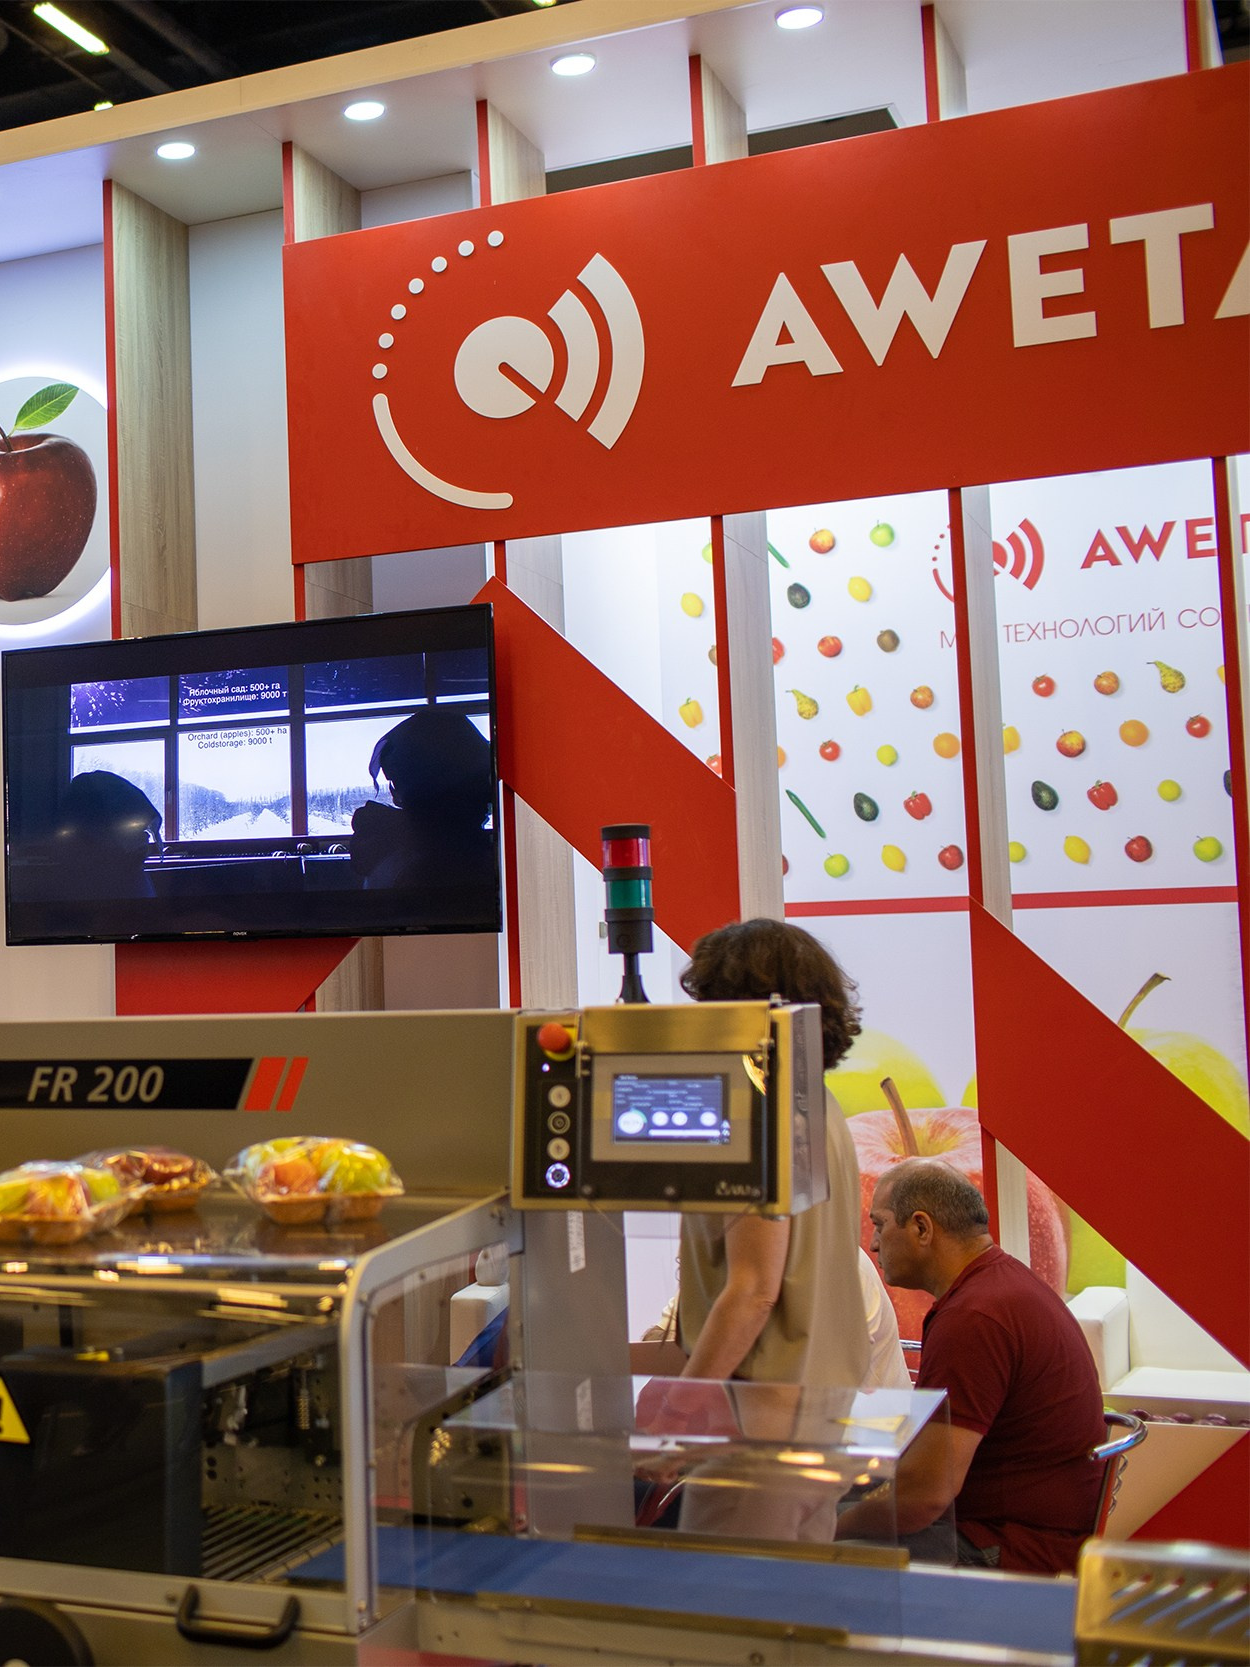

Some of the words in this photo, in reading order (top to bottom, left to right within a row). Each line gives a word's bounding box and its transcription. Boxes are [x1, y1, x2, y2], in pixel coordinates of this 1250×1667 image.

[1003, 607, 1166, 643] ТЕХНОЛОГИЙ
[1177, 606, 1222, 629] СО
[189, 686, 229, 697] Яблочный
[231, 686, 248, 694] сад:
[250, 683, 270, 692] 500+
[183, 693, 259, 707] Фруктохранилище:
[260, 691, 280, 700] 9000
[188, 731, 218, 742] Orchard
[220, 729, 254, 741] (apples):
[255, 728, 275, 736] 500+
[277, 727, 287, 735] ha
[198, 738, 246, 750] Coldstorage:
[248, 737, 268, 746] 9000
[27, 1066, 78, 1103] FR
[86, 1065, 165, 1103] 200
